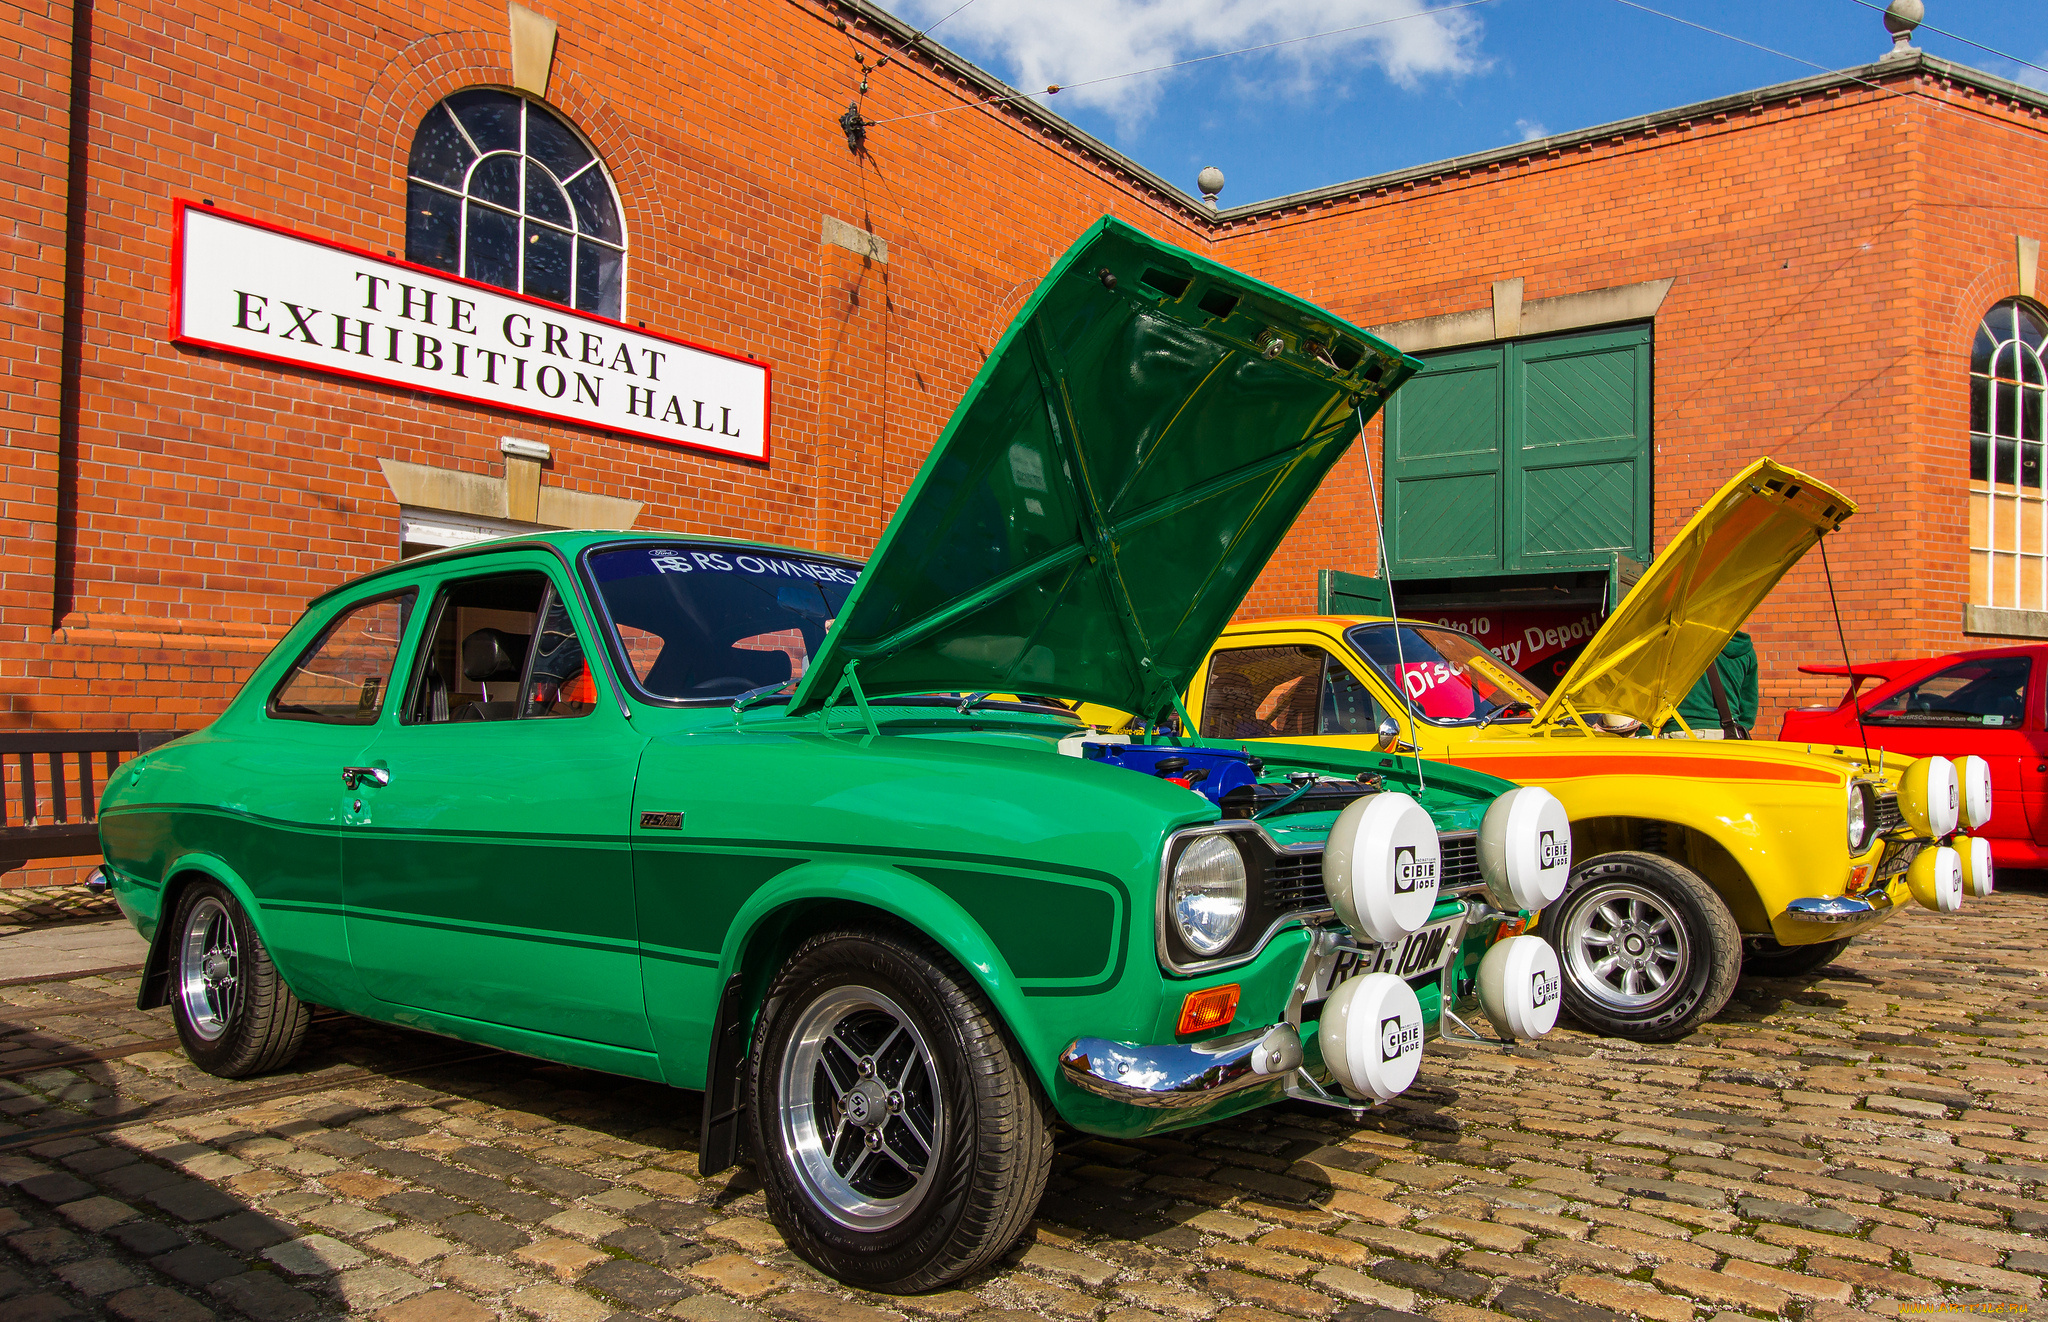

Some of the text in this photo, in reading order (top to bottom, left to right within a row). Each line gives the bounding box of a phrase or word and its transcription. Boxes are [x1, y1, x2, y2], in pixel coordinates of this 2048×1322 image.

[354, 271, 667, 382] THE GREAT
[232, 289, 741, 438] EXHIBITION HALL
[690, 552, 733, 571] RS
[735, 555, 856, 585] OWNERS
[1470, 617, 1490, 635] 10
[1524, 612, 1598, 653] Depot!
[850, 1095, 867, 1118] RS
